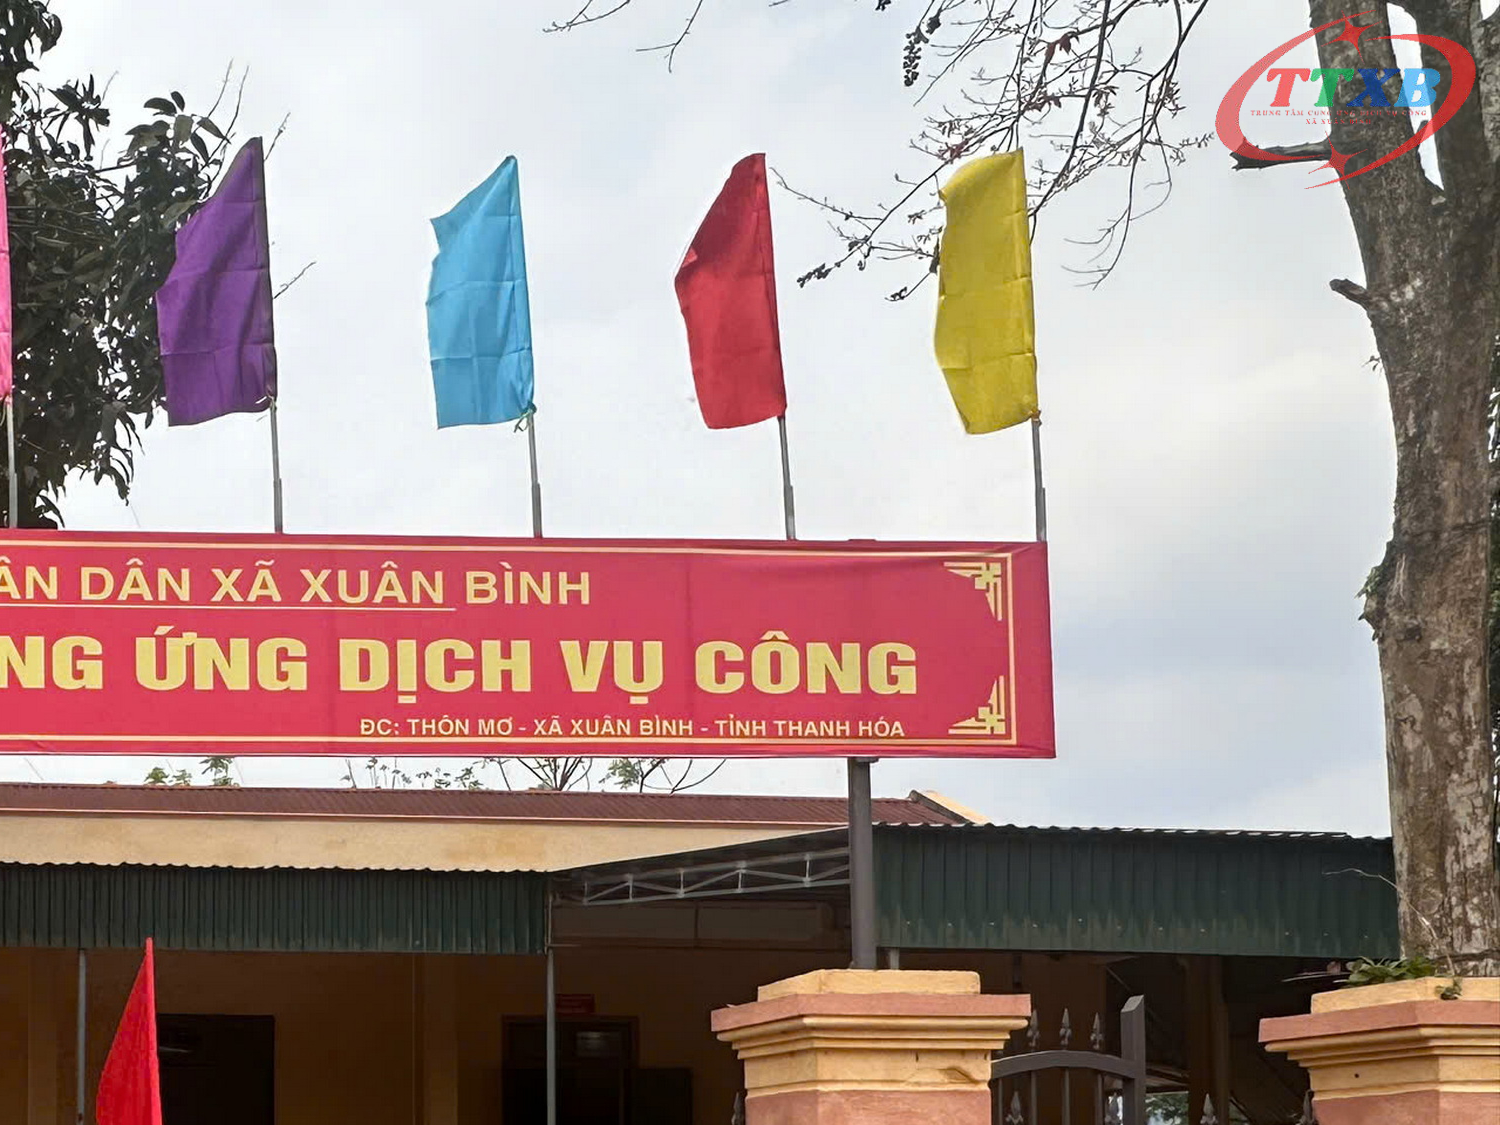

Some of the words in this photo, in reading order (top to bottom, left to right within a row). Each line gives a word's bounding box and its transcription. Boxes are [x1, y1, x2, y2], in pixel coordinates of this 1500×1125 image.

[80, 557, 191, 602] DÂN
[210, 559, 282, 603] XÃ
[299, 560, 444, 604] XUÂN
[465, 561, 590, 605] BÌNH
[135, 625, 308, 692] ỨNG
[339, 638, 532, 704] DỊCH
[559, 640, 664, 705] VỤ
[695, 630, 917, 695] CÔNG
[360, 718, 399, 736] ĐC:
[406, 714, 470, 736] THÔN
[477, 716, 513, 736] MƠ
[533, 715, 563, 736] XÃ
[570, 714, 631, 736] XUÂN
[639, 714, 693, 736] BÌNH
[714, 713, 767, 737] TỈNH
[773, 720, 851, 737] THANH
[858, 716, 905, 737] HÓA
